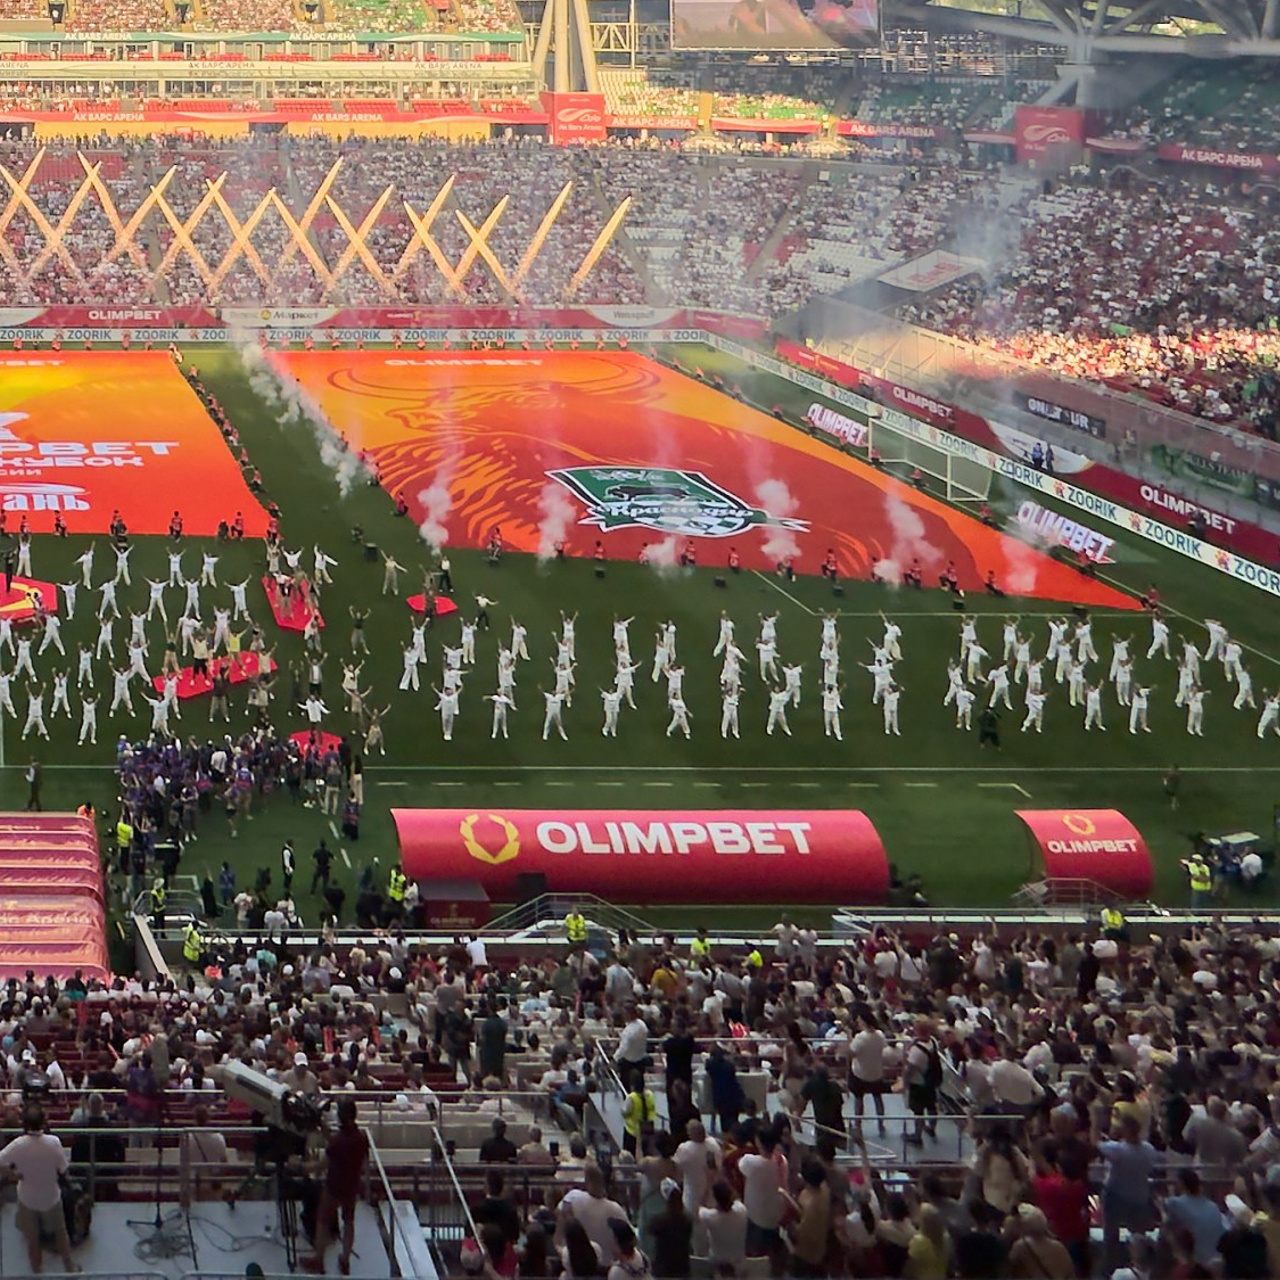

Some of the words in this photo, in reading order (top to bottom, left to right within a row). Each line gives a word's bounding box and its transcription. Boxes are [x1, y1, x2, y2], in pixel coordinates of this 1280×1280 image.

[612, 117, 626, 126] АК
[628, 117, 655, 126] БАРС
[657, 118, 692, 127] АРЕНА
[850, 124, 866, 133] AK
[867, 125, 896, 135] BARS
[897, 126, 935, 137] ARENA
[1181, 149, 1195, 160] АК
[1197, 150, 1225, 163] БАРС
[1226, 154, 1263, 167] АРЕНА
[88, 310, 162, 320] OLIMPBET
[0, 329, 44, 339] ZOORIK
[67, 329, 112, 340] ZOORIK
[134, 329, 179, 340] ZOORIK
[269, 329, 313, 340] ZOORIK
[337, 329, 381, 340] ZOORIK
[404, 329, 448, 340] ZOORIK
[471, 329, 516, 340] ZOORIK
[538, 330, 583, 340] ZOORIK
[892, 386, 953, 418] OLIMPBET
[939, 432, 978, 461] ZOORIK
[999, 458, 1043, 488] ZOORIK
[1068, 486, 1118, 521] ZOORIK
[1017, 501, 1116, 562] OLIMPBET
[1145, 520, 1203, 559] ZOORIK
[536, 822, 811, 854] OLIMPBET
[1047, 839, 1137, 853] OLIMPBET
